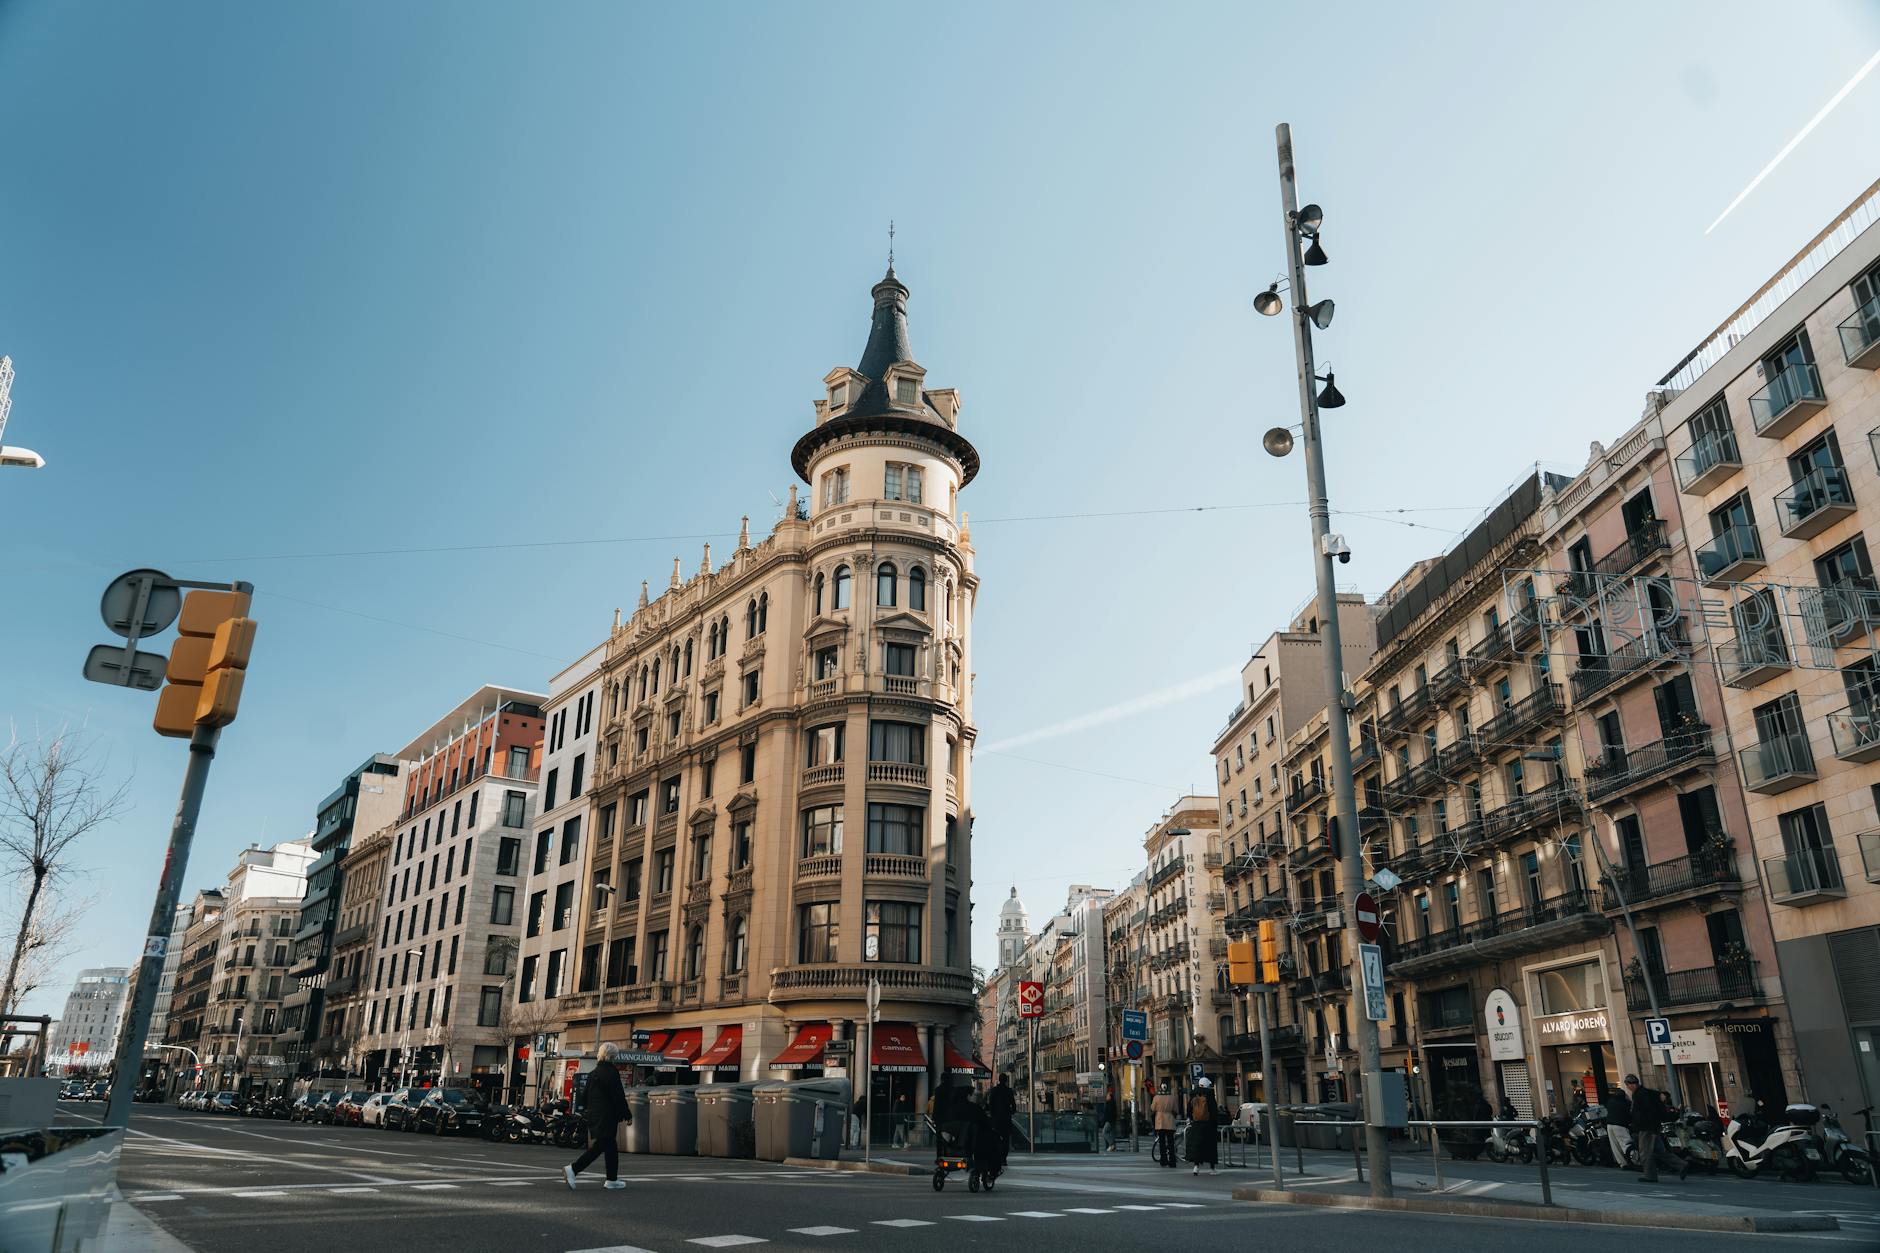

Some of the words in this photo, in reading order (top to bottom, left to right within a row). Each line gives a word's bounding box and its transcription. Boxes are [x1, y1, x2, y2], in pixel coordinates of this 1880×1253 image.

[1187, 853, 1197, 908] HOTEL
[1190, 927, 1202, 1006] MIDMOST
[1028, 989, 1037, 998] M
[1542, 1020, 1571, 1033] ALVARO
[1572, 1016, 1607, 1030] MORENO
[1650, 1022, 1665, 1042] P
[1724, 1022, 1761, 1033] lemon
[537, 1035, 544, 1050] P
[620, 1053, 662, 1063] VANGUARDIA
[1193, 1065, 1202, 1076] P
